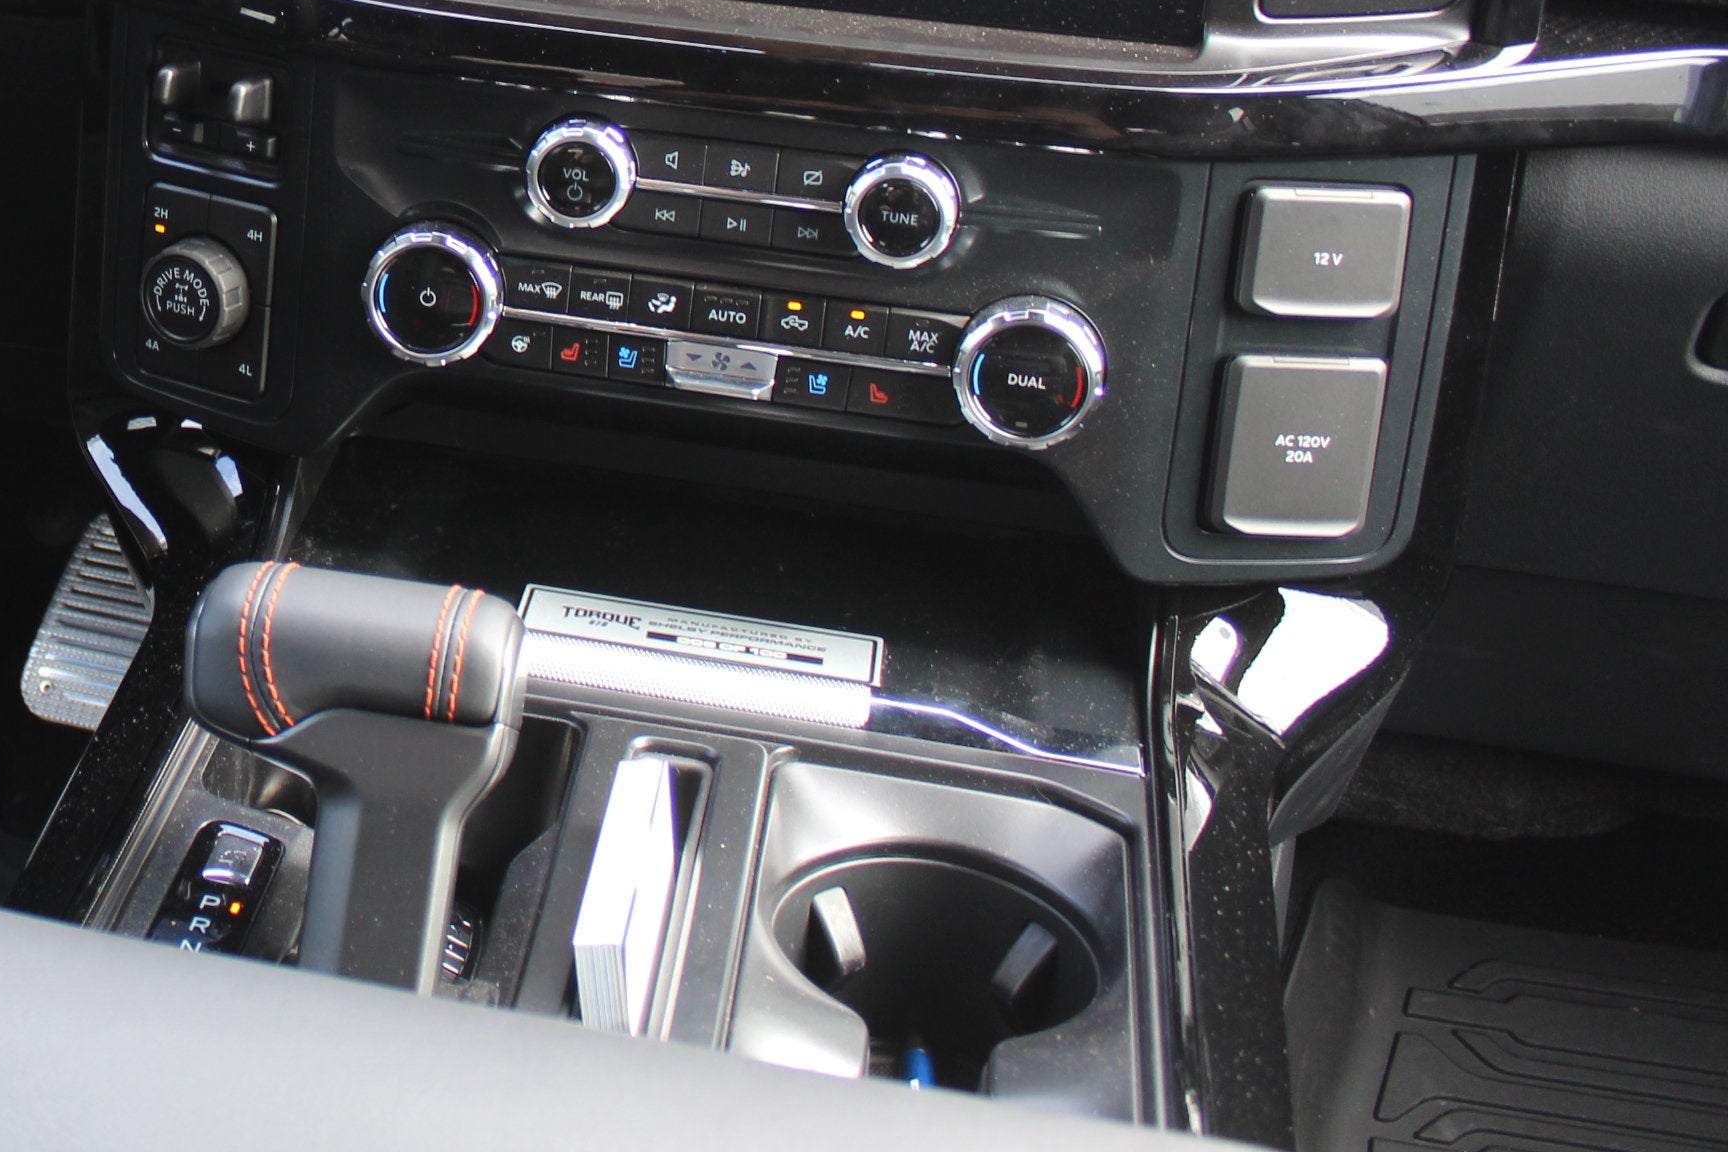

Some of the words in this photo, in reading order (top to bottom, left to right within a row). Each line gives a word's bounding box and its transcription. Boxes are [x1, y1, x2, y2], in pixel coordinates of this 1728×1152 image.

[562, 167, 590, 182] VOL
[154, 206, 169, 220] 2H
[880, 209, 919, 228] TUNE
[246, 229, 263, 243] 4H
[1313, 251, 1329, 266] 12
[1331, 253, 1344, 267] V
[153, 267, 181, 297] DRIVE
[183, 268, 210, 307] MODE
[518, 282, 541, 295] MAX
[580, 290, 605, 303] REAR
[166, 300, 196, 317] PUSH
[707, 308, 747, 325] AUTO
[844, 324, 870, 340] A/C
[908, 329, 939, 344] MAX
[145, 338, 160, 352] 4A
[909, 340, 935, 354] A/C
[238, 363, 253, 377] 4L
[1007, 373, 1046, 391] DUAL
[1274, 433, 1294, 448] AC
[1297, 435, 1331, 450] 120V
[1285, 450, 1314, 464] 20A
[562, 605, 642, 631] TORQUE
[199, 894, 221, 910] P
[188, 916, 211, 934] R
